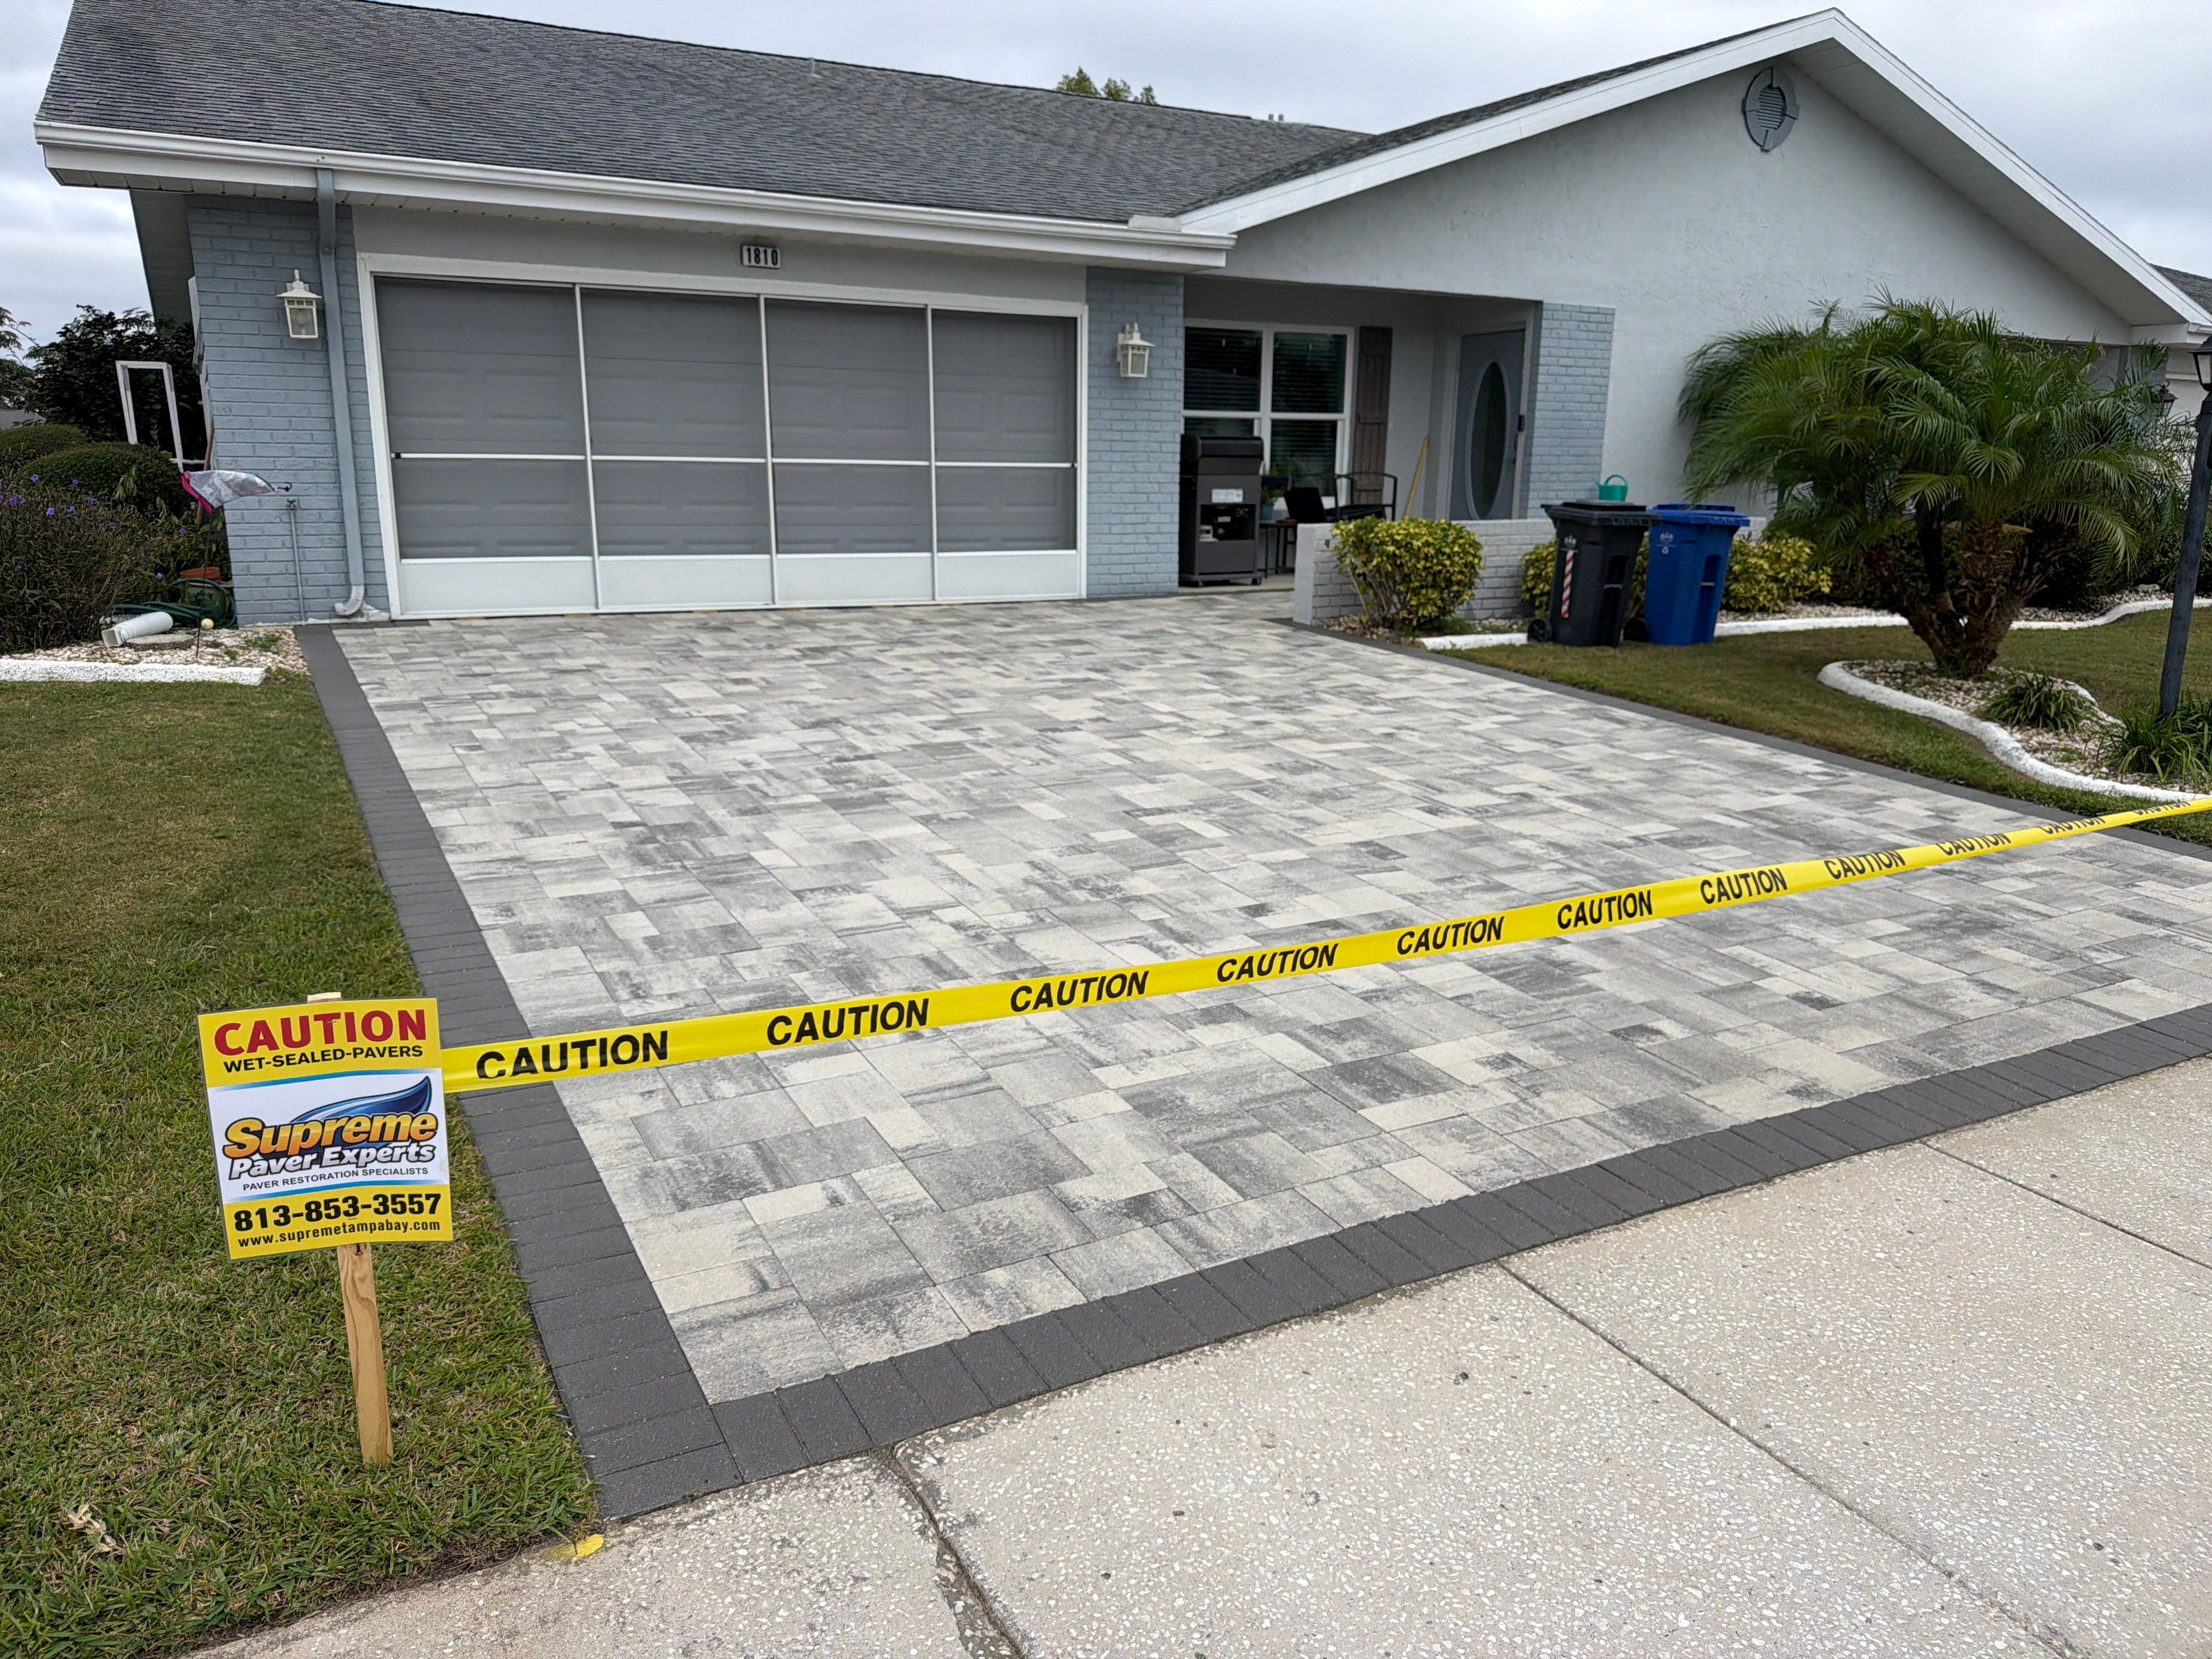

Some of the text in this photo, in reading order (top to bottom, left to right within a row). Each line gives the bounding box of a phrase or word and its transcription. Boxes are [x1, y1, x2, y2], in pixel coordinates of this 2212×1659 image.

[747, 247, 777, 266] 1810
[476, 1030, 669, 1079] CAUTION
[767, 998, 929, 1046] CAUTION
[1010, 970, 1149, 1013] CAUTION
[1217, 943, 1339, 983] CAUTION
[1397, 916, 1505, 956] CAUTION
[1557, 890, 1652, 929] CAUTION
[1700, 868, 1787, 904] CAUTION
[1824, 850, 1906, 879] CAUTION
[1936, 832, 2012, 856] CAUTION
[214, 1009, 426, 1056] CAUTION
[223, 1045, 424, 1073] WET-SEALED-PAVERS
[223, 1112, 438, 1159] Supreme
[228, 1143, 436, 1181] Paver Experts
[243, 1167, 428, 1191] PAVER RESTORATION SPECIALISTS
[234, 1193, 442, 1232] 813-853-3557
[238, 1220, 441, 1247] www.supremetampabay.com
